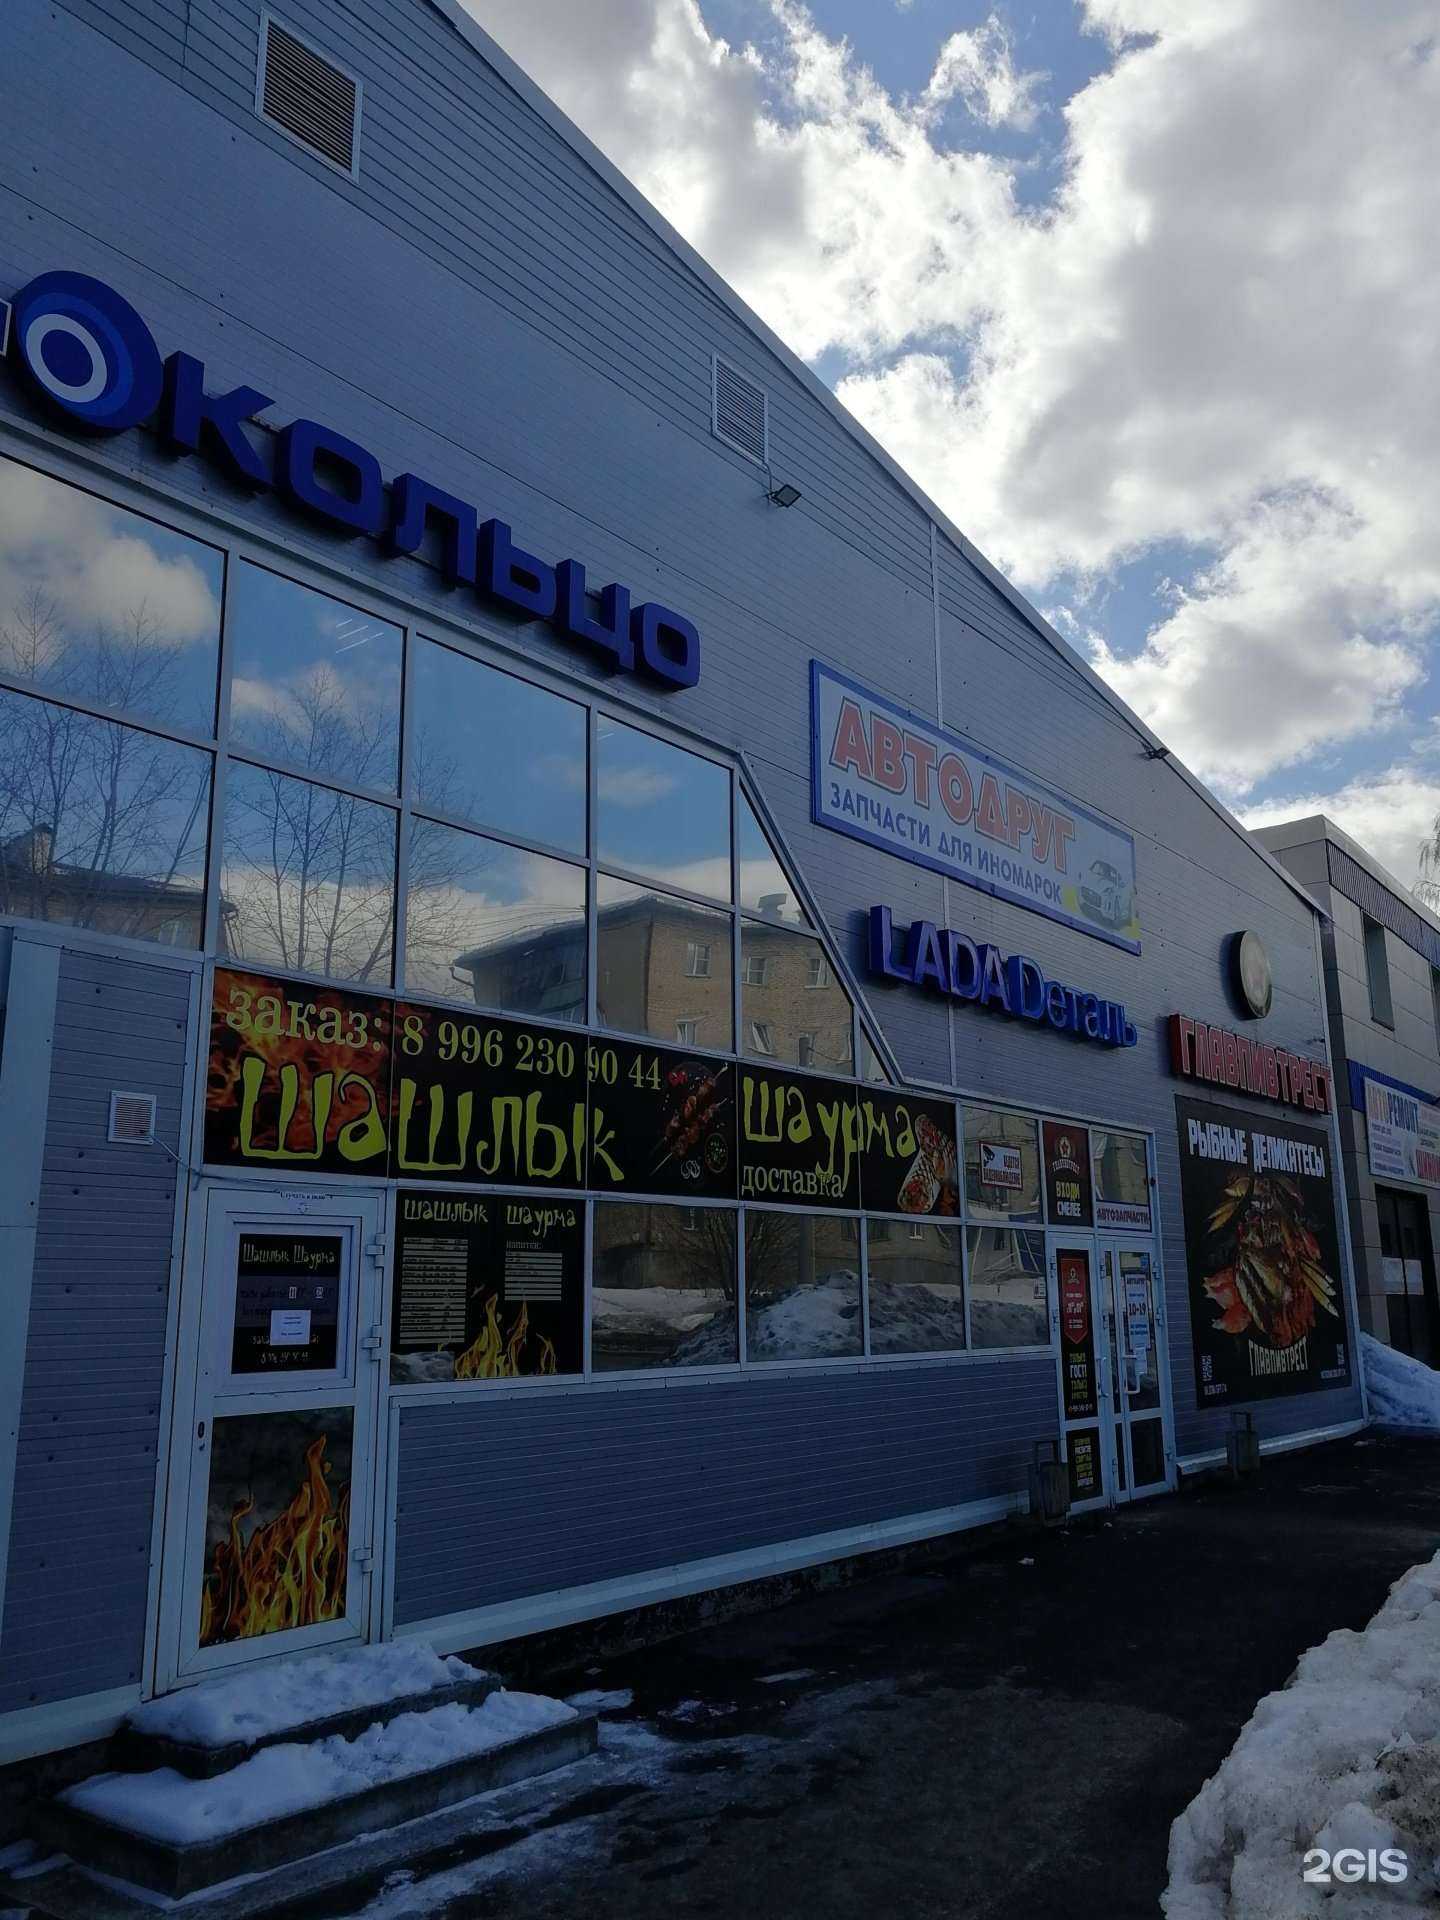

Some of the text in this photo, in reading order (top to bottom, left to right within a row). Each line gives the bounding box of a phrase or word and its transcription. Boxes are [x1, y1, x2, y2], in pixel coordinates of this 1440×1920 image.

[829, 696, 1076, 874] АВТОДРУГ
[830, 782, 1062, 905] ЗАПЧАСТИ ДЛЯ ИНОМАРОК
[866, 904, 1011, 1011] LADA
[402, 1014, 425, 1057] 8
[437, 1019, 504, 1068] 996
[515, 1033, 575, 1078] 230
[586, 1046, 619, 1085] 90
[627, 1054, 662, 1090] 44
[1172, 1015, 1332, 1114] ГЛАВПИВТРЕСТ
[741, 1164, 845, 1198] доставка
[1187, 1118, 1248, 1165] РЫБНЫЕ
[1251, 1132, 1326, 1179] ДЕЛИКАТЕСЫ
[1055, 1181, 1080, 1201] ВХОДИ
[1057, 1200, 1082, 1217] СМЕЛЕЕ
[1248, 1336, 1309, 1377] ГЛАВПИВТРЕСТ
